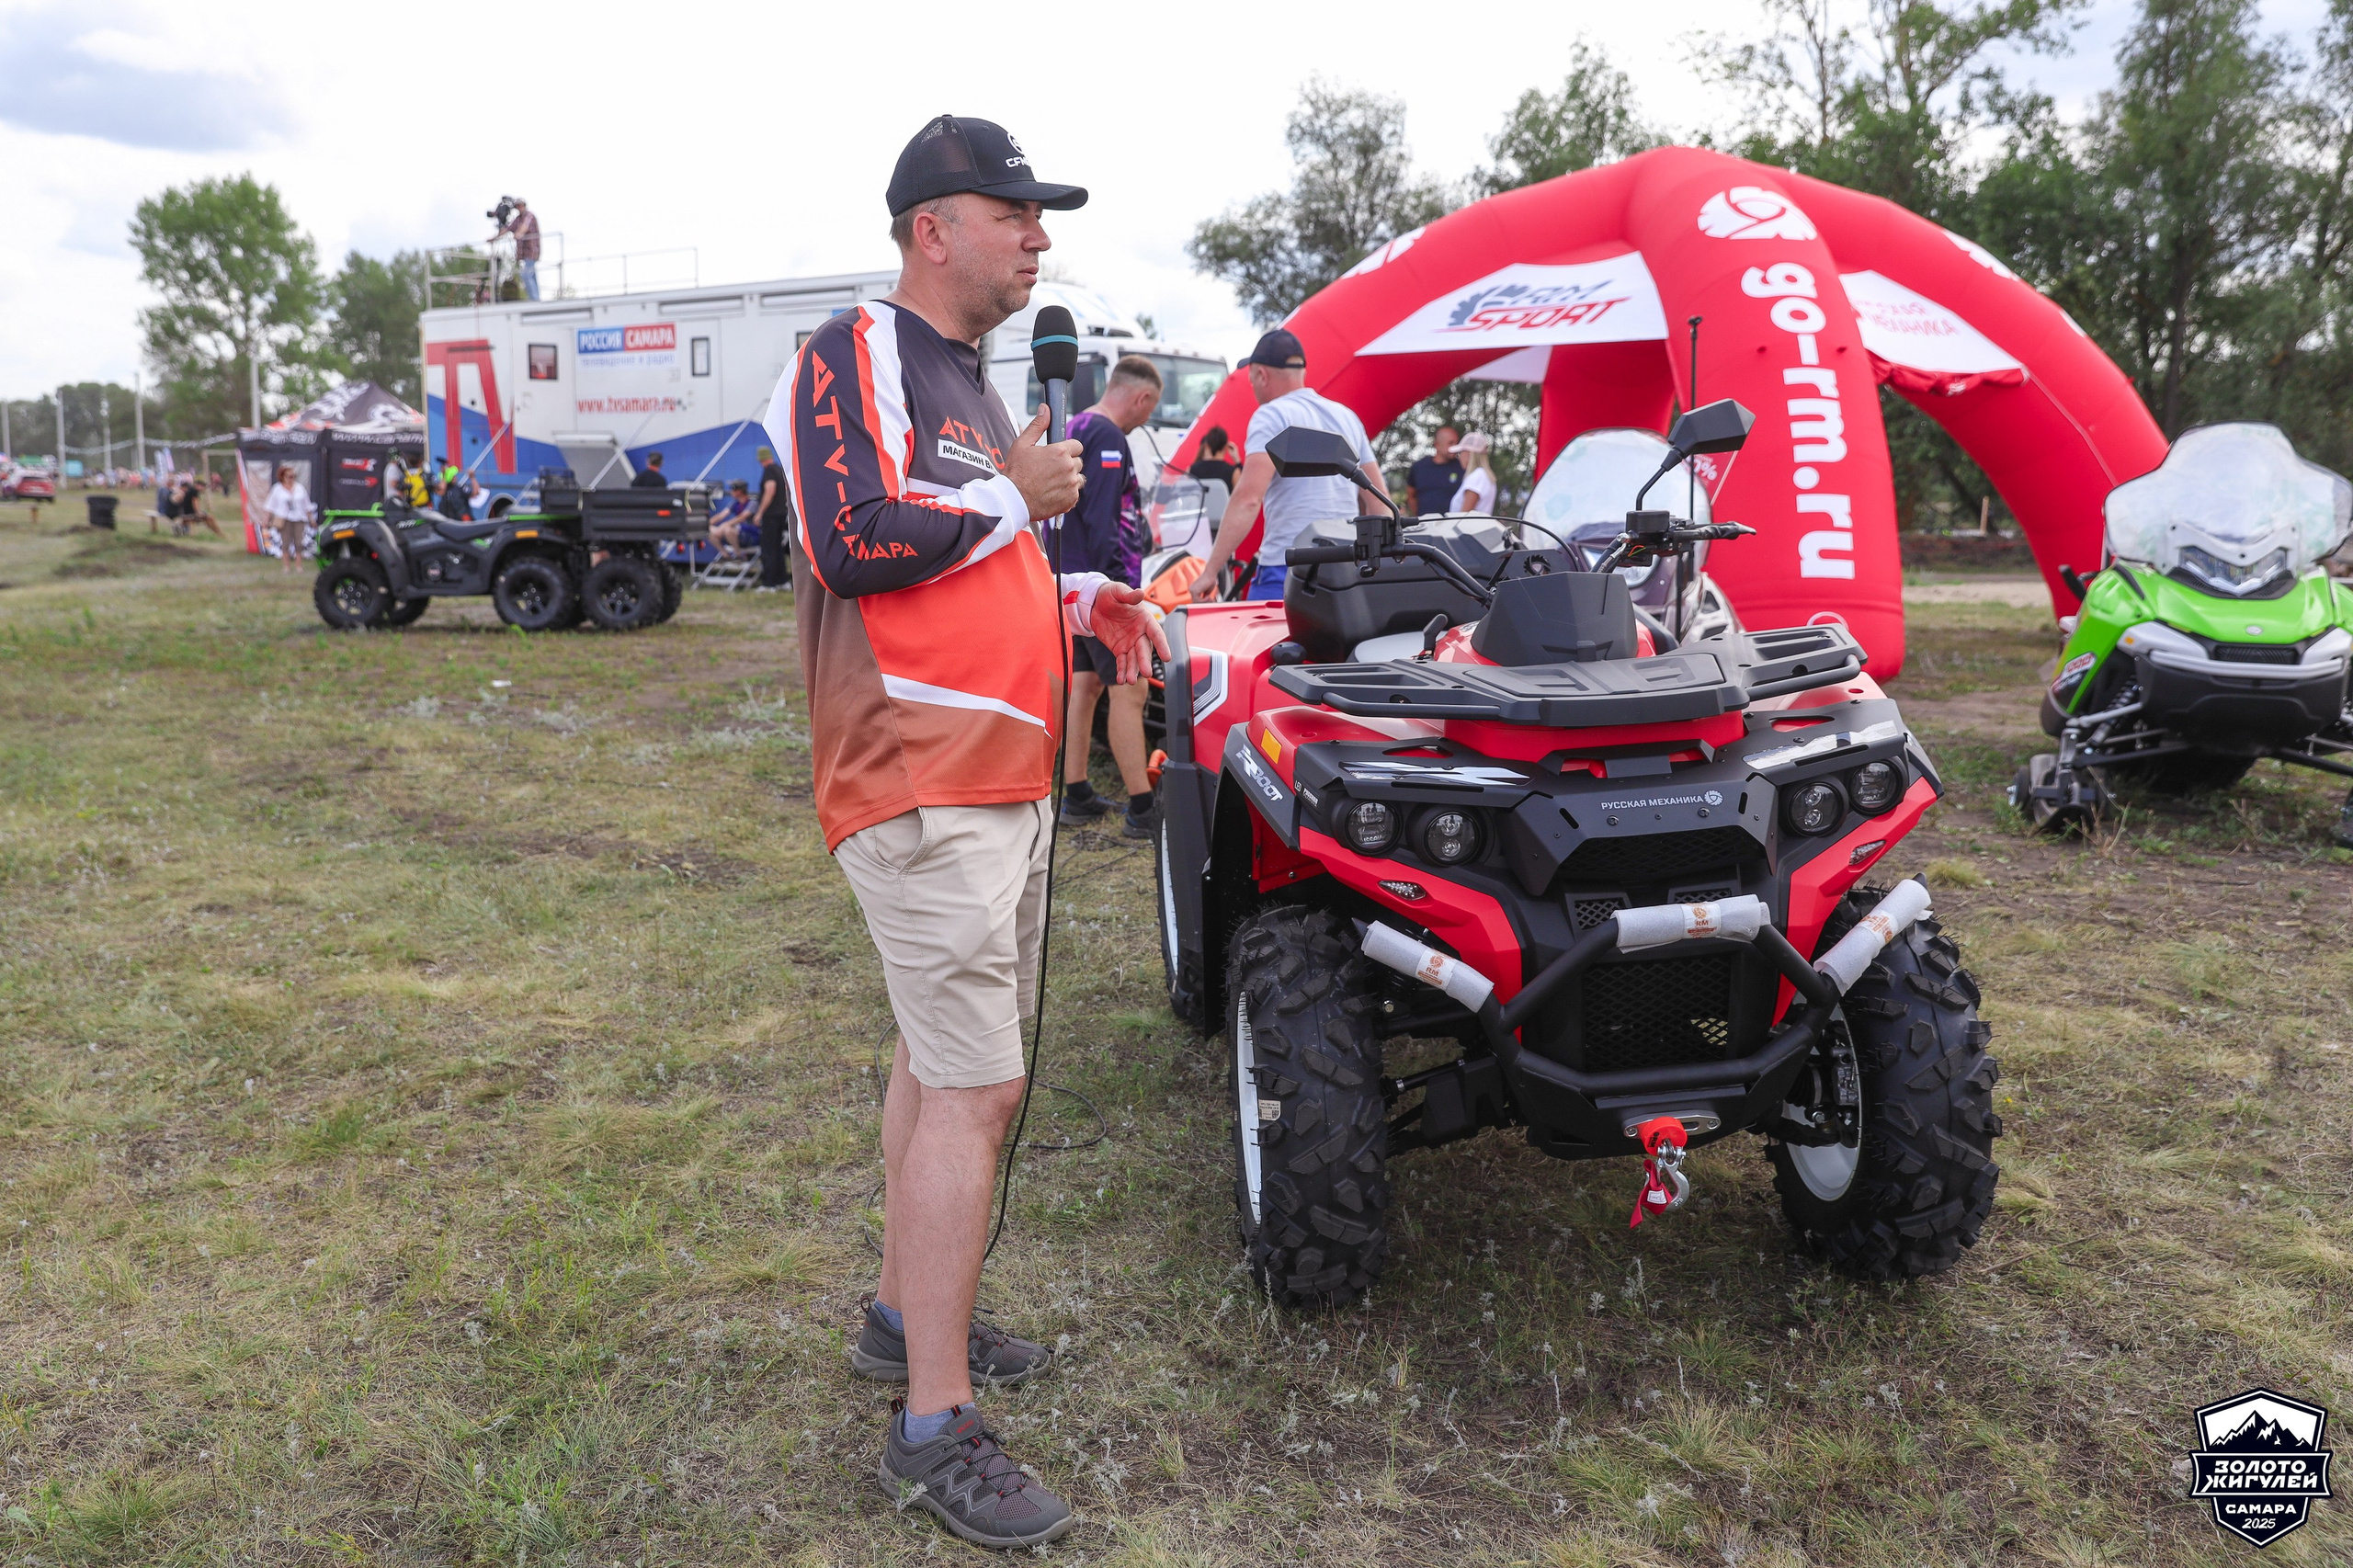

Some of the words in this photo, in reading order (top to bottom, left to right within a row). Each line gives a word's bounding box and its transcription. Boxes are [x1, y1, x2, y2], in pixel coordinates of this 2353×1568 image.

[1005, 155, 1030, 168] CFM
[1434, 296, 1632, 333] SPORT
[580, 332, 622, 351] РОССИЯ
[626, 327, 675, 349] САМАРА
[1741, 262, 1855, 580] go-rm.ru
[943, 445, 984, 467] МАГАЗИН
[1601, 800, 1647, 810] РУССКАЯ
[1648, 794, 1704, 807] МЕХАНИКА
